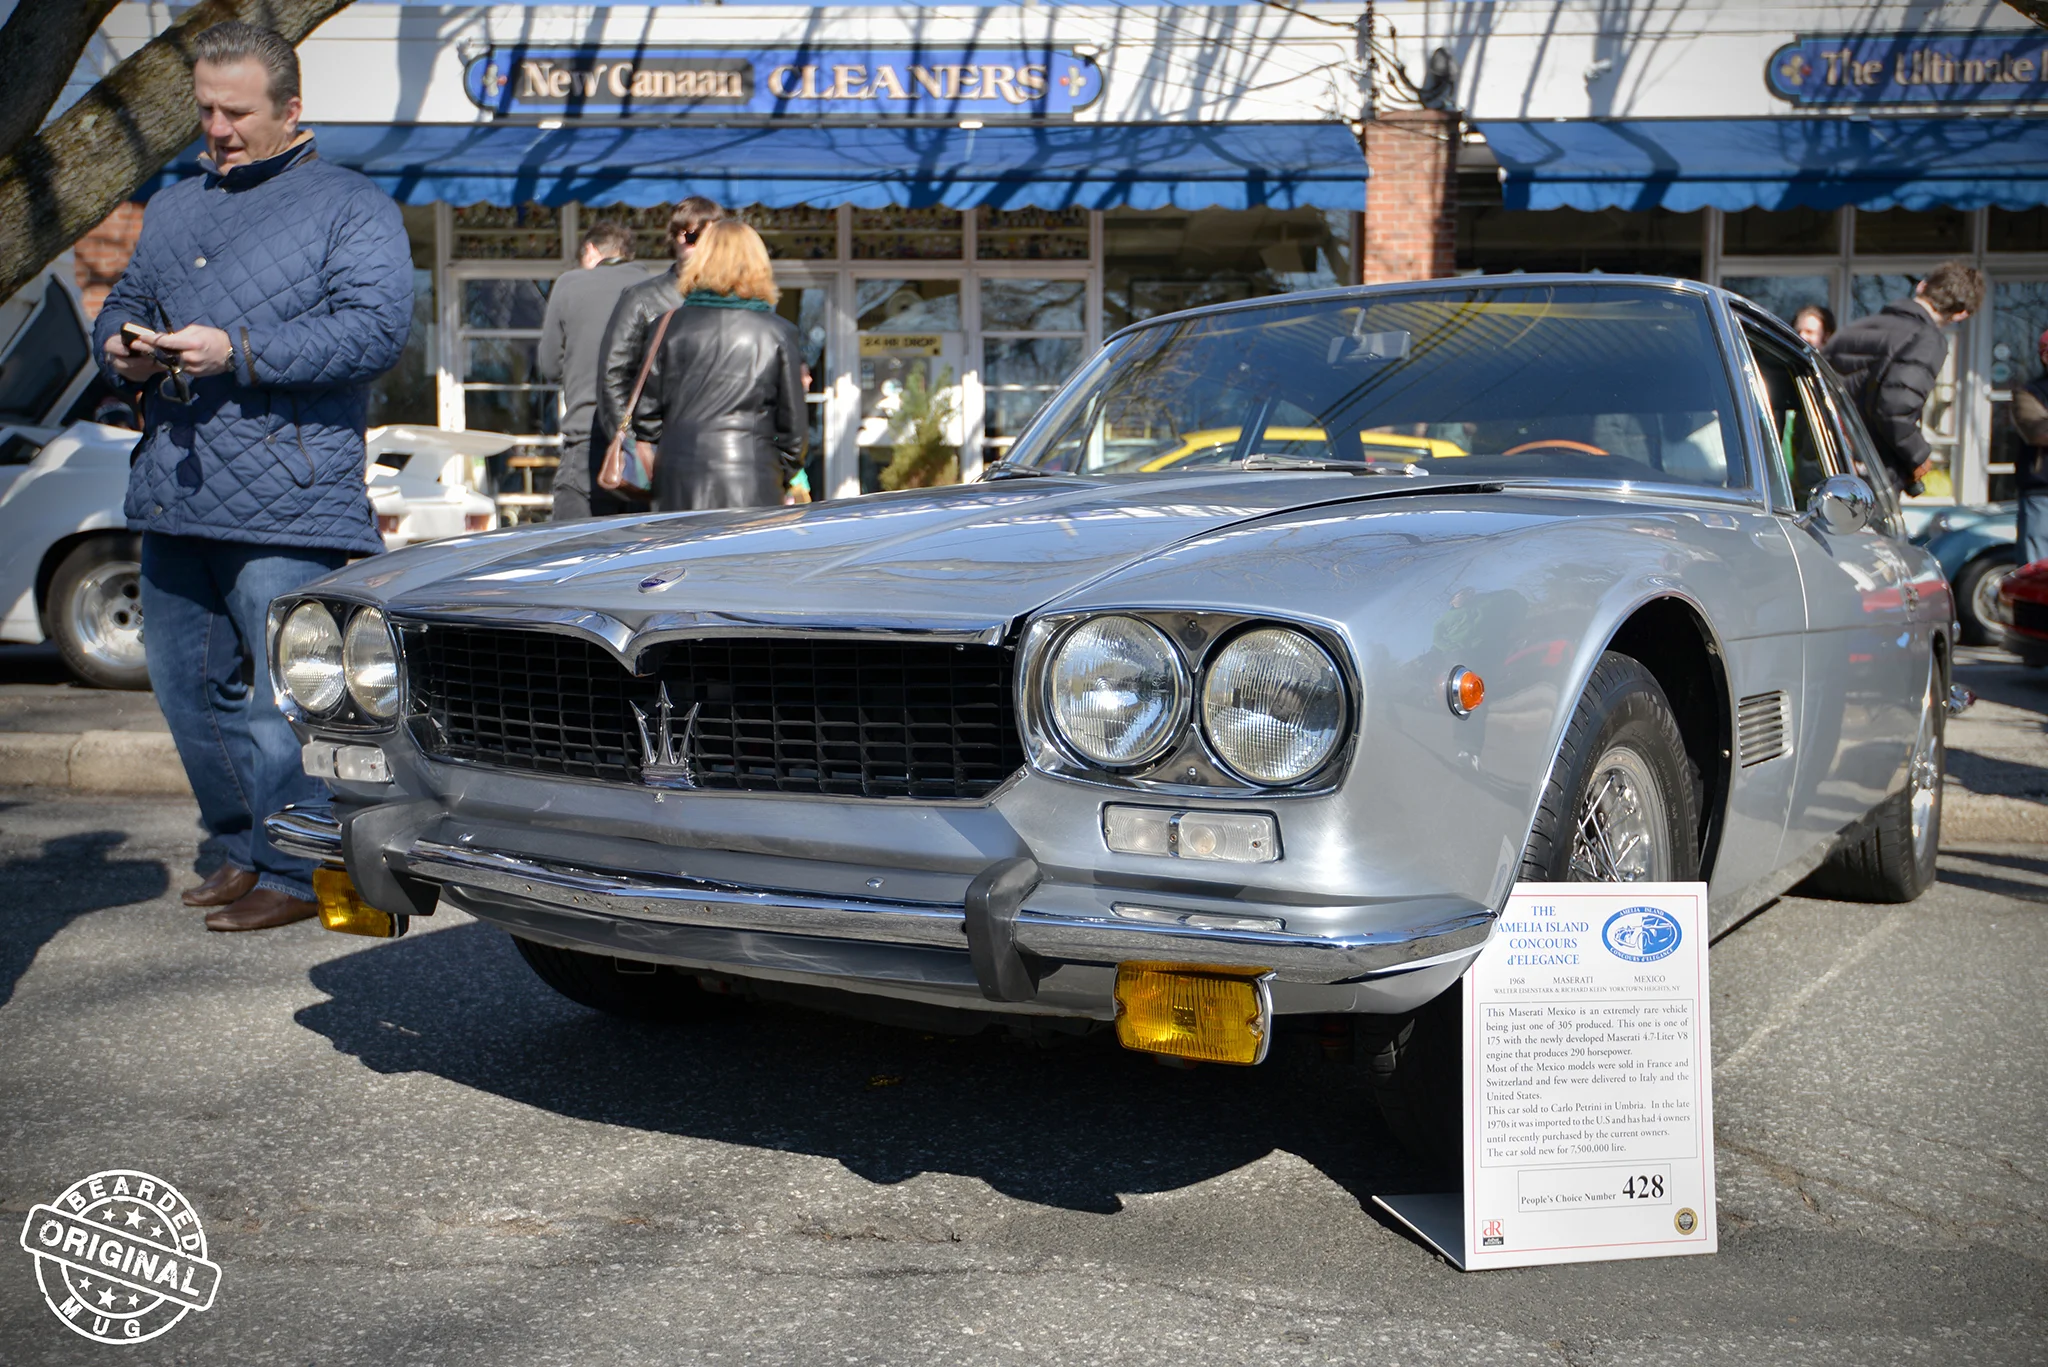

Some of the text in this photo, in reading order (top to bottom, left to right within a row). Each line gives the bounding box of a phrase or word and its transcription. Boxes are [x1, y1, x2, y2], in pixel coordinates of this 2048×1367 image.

[1821, 48, 1883, 85] The
[1894, 48, 2034, 84] Ultimate
[521, 62, 1048, 103] New Canaan CLEANERS
[904, 338, 936, 347] DROP
[1531, 906, 1556, 916] THE
[1497, 922, 1589, 933] AMELIA ISLAND
[1510, 938, 1578, 949] CONCOURS
[1553, 976, 1594, 984] MASERATI
[1634, 975, 1666, 983] MEXICO
[1486, 1008, 1504, 1017] This
[1509, 1008, 1543, 1016] Maserati
[1548, 1007, 1576, 1016] Mexico
[1580, 1007, 1586, 1015] is
[1603, 1006, 1640, 1016] extremely
[1663, 1005, 1687, 1013] vehicle
[1486, 1022, 1508, 1033] being
[1511, 1022, 1526, 1031] just
[1546, 1021, 1556, 1029] of
[1558, 1021, 1572, 1029] 305
[1576, 1020, 1613, 1031] produced.
[1617, 1019, 1635, 1028] This
[1655, 1019, 1660, 1027] is
[1680, 1018, 1689, 1026] of
[1487, 1036, 1500, 1045] 175
[1504, 1036, 1522, 1044] with
[1525, 1035, 1537, 1043] the
[1540, 1035, 1563, 1045] newly
[1566, 1033, 1604, 1045] developed
[1607, 1033, 1640, 1042] Maserati
[1678, 1032, 1688, 1040] V8
[1486, 1047, 1632, 1061] engine that produces 290 horsepower.
[1486, 1064, 1507, 1073] Most
[1510, 1063, 1519, 1072] of
[1521, 1063, 1533, 1072] the
[1536, 1063, 1565, 1071] Mexico
[1568, 1061, 1595, 1071] models
[1619, 1060, 1633, 1069] sold
[1636, 1060, 1644, 1068] in
[1647, 1059, 1672, 1068] France
[1675, 1058, 1689, 1067] and
[1486, 1077, 1533, 1087] Switzerland
[1536, 1076, 1551, 1085] and
[1554, 1076, 1568, 1085] few
[1592, 1074, 1626, 1083] delivered
[1640, 1073, 1657, 1083] Italy
[1660, 1072, 1674, 1081] and
[1677, 1072, 1689, 1080] the
[1486, 1091, 1542, 1101] United States.
[1486, 1106, 1505, 1115] This
[1522, 1104, 1538, 1113] sold
[1551, 1103, 1573, 1113] Carlo
[1575, 1102, 1602, 1112] Petrini
[1605, 1102, 1612, 1110] in
[1615, 1101, 1646, 1110] Umbria.
[1651, 1100, 1659, 1108] In
[1662, 1099, 1674, 1108] the
[1677, 1099, 1690, 1108] late
[1487, 1120, 1510, 1129] 1970s
[1512, 1119, 1516, 1128] it
[1535, 1117, 1571, 1129] imported
[1582, 1116, 1594, 1125] the
[1596, 1115, 1610, 1125] U.S
[1612, 1115, 1626, 1124] and
[1628, 1115, 1640, 1123] has
[1642, 1114, 1655, 1123] had
[1657, 1113, 1662, 1122] 4
[1487, 1134, 1506, 1143] until
[1509, 1132, 1540, 1144] recently
[1542, 1130, 1582, 1143] purchased
[1584, 1130, 1594, 1141] by
[1596, 1130, 1608, 1138] the
[1610, 1129, 1638, 1138] current
[1487, 1148, 1503, 1157] The
[1520, 1147, 1536, 1155] sold
[1557, 1145, 1568, 1154] for
[1571, 1144, 1609, 1154] 7,500,000
[1612, 1143, 1626, 1152] lire.
[1556, 1193, 1583, 1203] Choice
[1585, 1192, 1616, 1201] Number
[1622, 1174, 1664, 1199] 428
